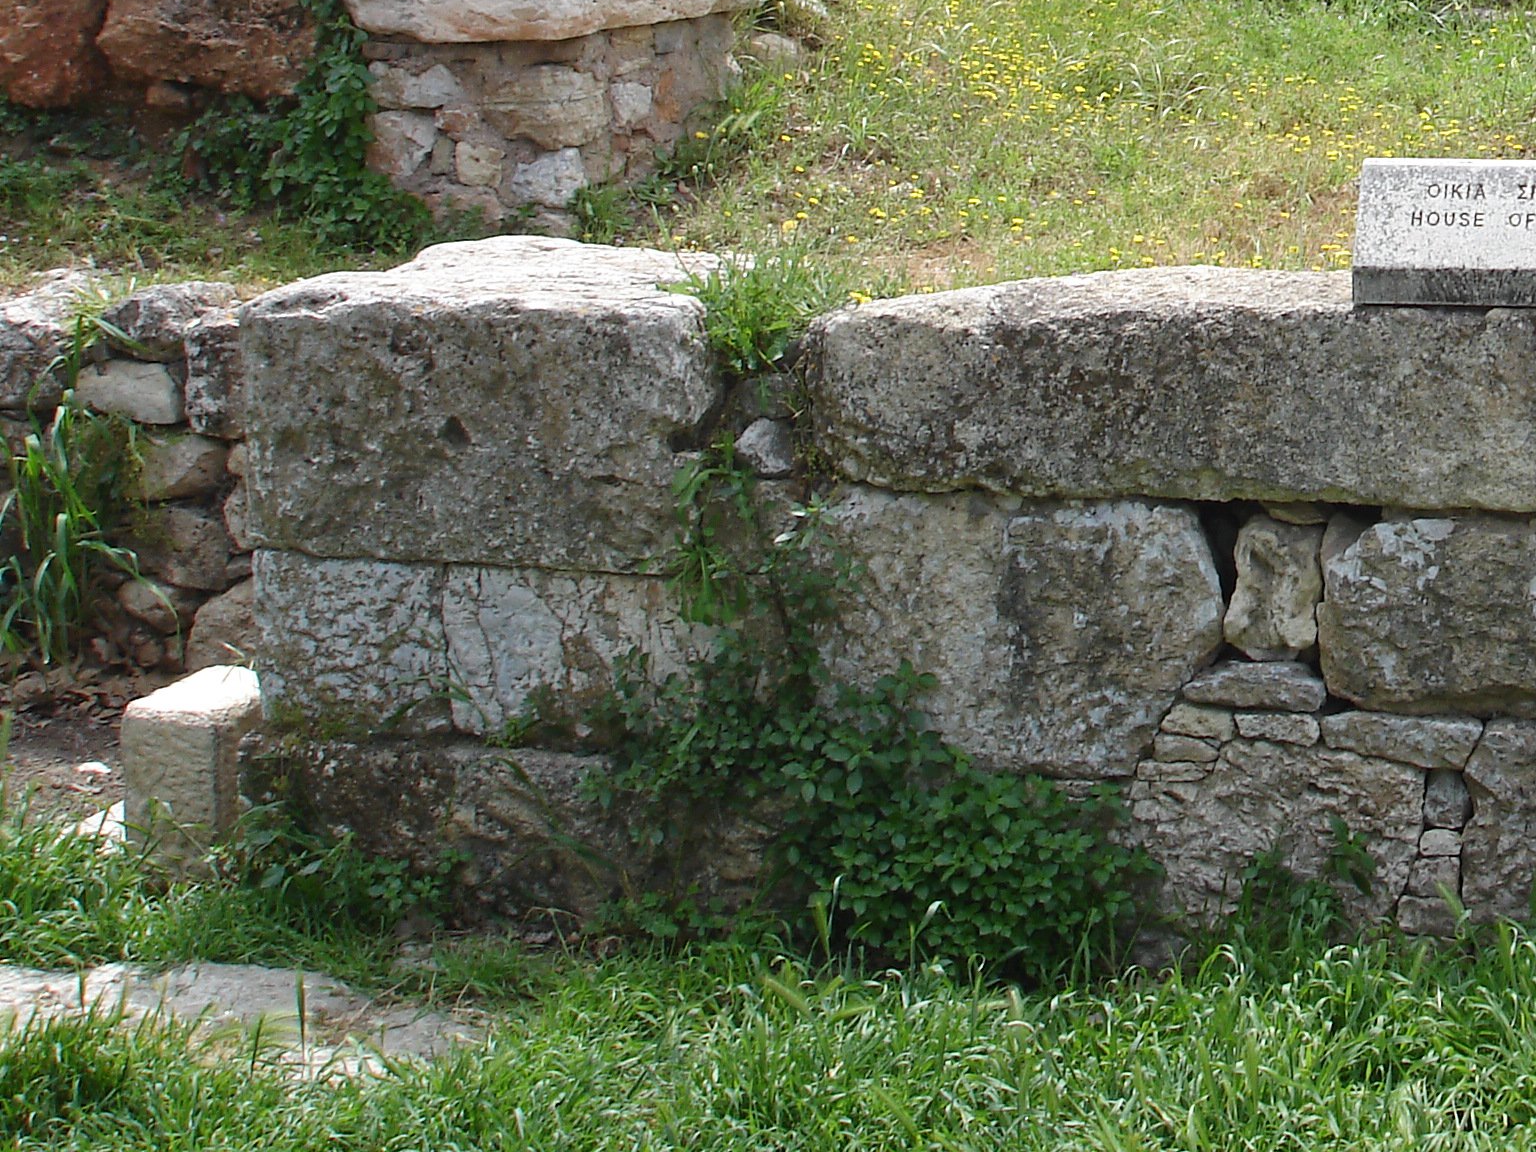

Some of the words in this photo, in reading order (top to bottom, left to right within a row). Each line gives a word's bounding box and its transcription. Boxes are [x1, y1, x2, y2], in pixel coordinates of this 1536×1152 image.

[1427, 183, 1487, 201] ΟΙΚΙΑ
[1410, 210, 1485, 228] HOUSE
[1508, 212, 1536, 229] OF
